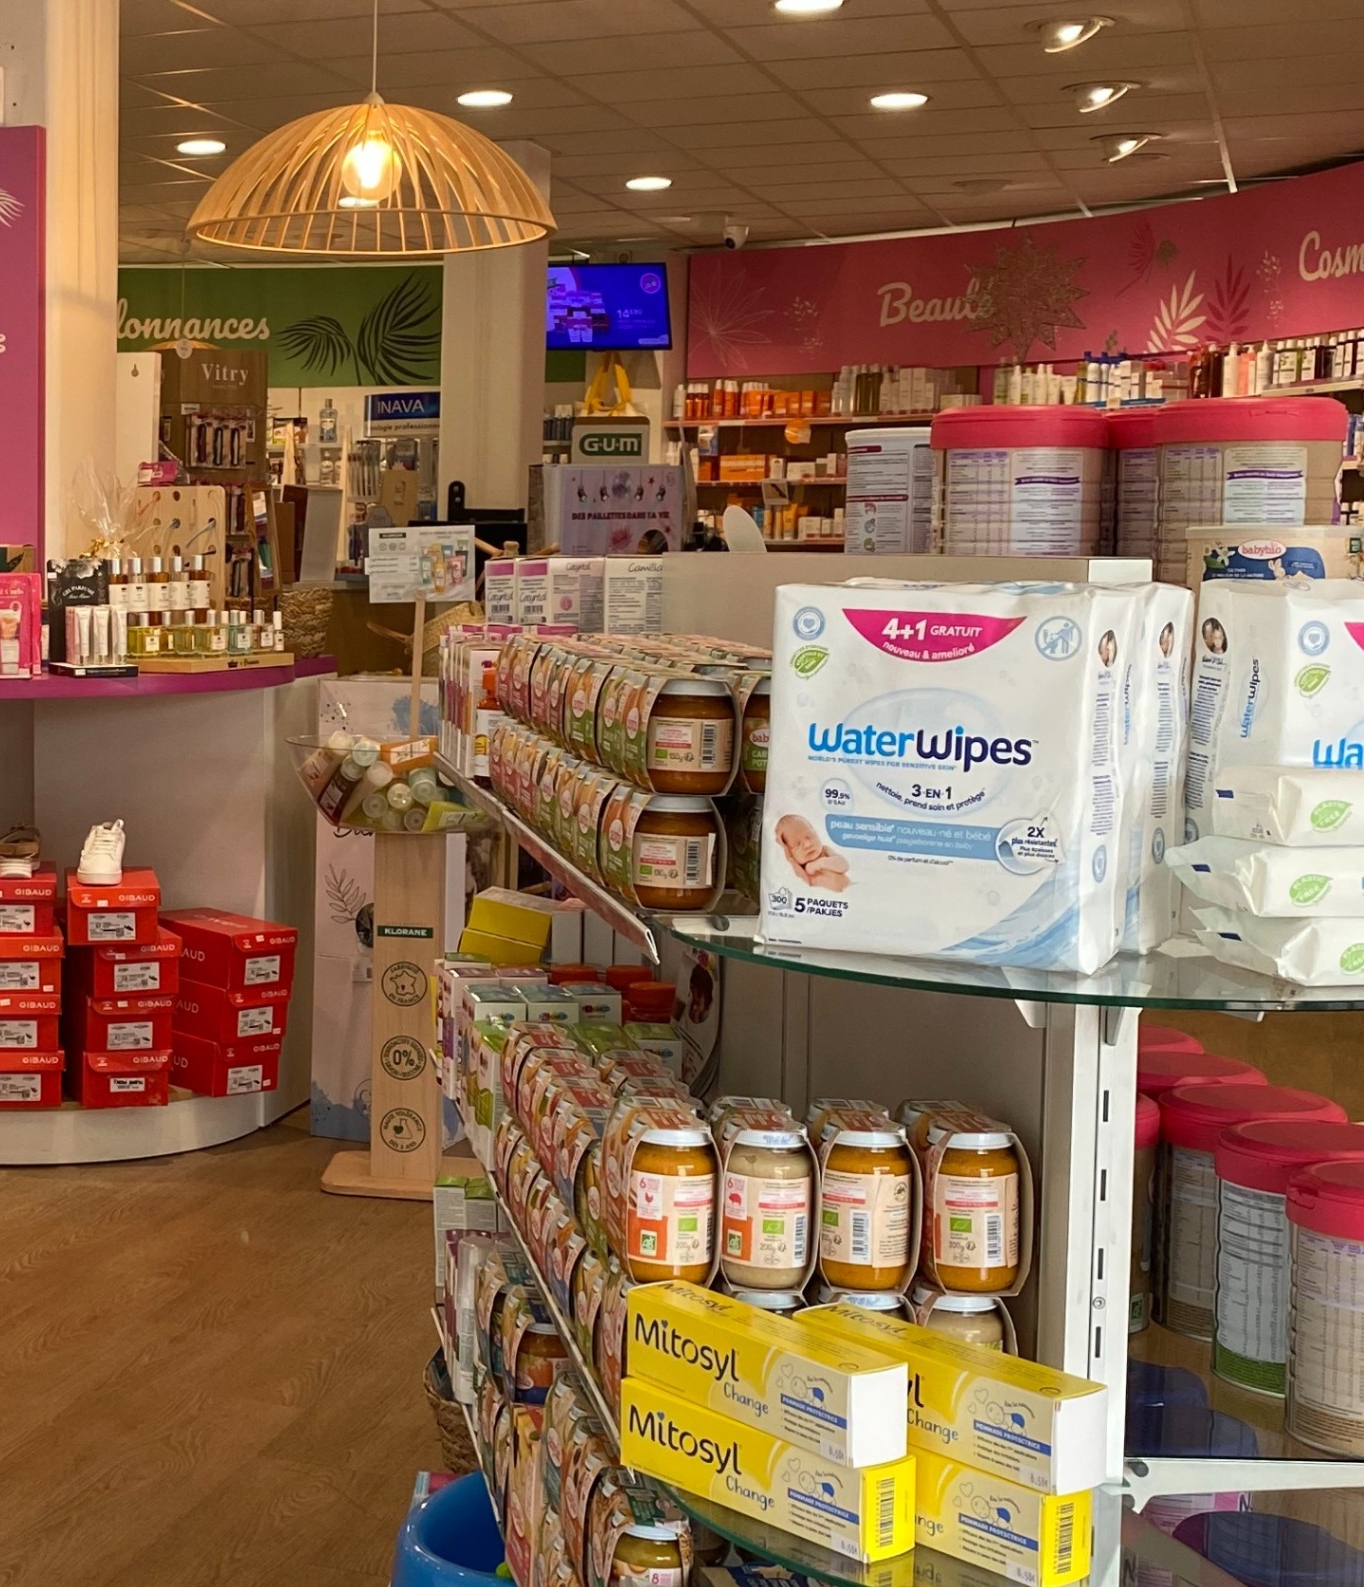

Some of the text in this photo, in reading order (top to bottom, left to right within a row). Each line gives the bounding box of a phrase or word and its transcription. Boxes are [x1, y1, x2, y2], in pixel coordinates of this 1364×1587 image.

[201, 363, 249, 385] Vitry
[377, 399, 425, 414] INAVA
[1242, 542, 1282, 557] babybio
[881, 618, 983, 641] 4+1 GRATUIT
[882, 641, 921, 659] nouveau
[922, 650, 931, 659] &
[903, 798, 927, 811] prend
[928, 802, 945, 811] soin
[946, 801, 955, 811] et
[830, 820, 853, 830] peau
[954, 831, 963, 839] et
[966, 830, 991, 842] bébé
[14, 888, 52, 897] GIBAUD
[118, 893, 155, 902] GIBAUD
[771, 895, 788, 904] 300
[794, 897, 849, 913] 5 PAQUETS
[806, 906, 843, 917] /PAKJES
[384, 928, 427, 936] KLORANE
[22, 944, 60, 952] GIBAUD
[140, 943, 175, 952] GIBAUD
[269, 936, 296, 946] GIBAUD
[19, 1001, 56, 1010] GIBAUD
[137, 1000, 172, 1008] GIBAUD
[253, 1043, 280, 1053] GIBAUD
[22, 1056, 59, 1064] GIBAUD
[133, 1055, 168, 1064] GIBAUD
[393, 1049, 414, 1066] 0%
[660, 1282, 733, 1312] Mitosyl
[825, 1305, 908, 1334] Mitosyl
[634, 1313, 740, 1382] Mitosyl
[723, 1380, 769, 1418] Change
[908, 1408, 959, 1444] Change
[629, 1404, 742, 1475] Mitosyl
[726, 1474, 775, 1511] Change
